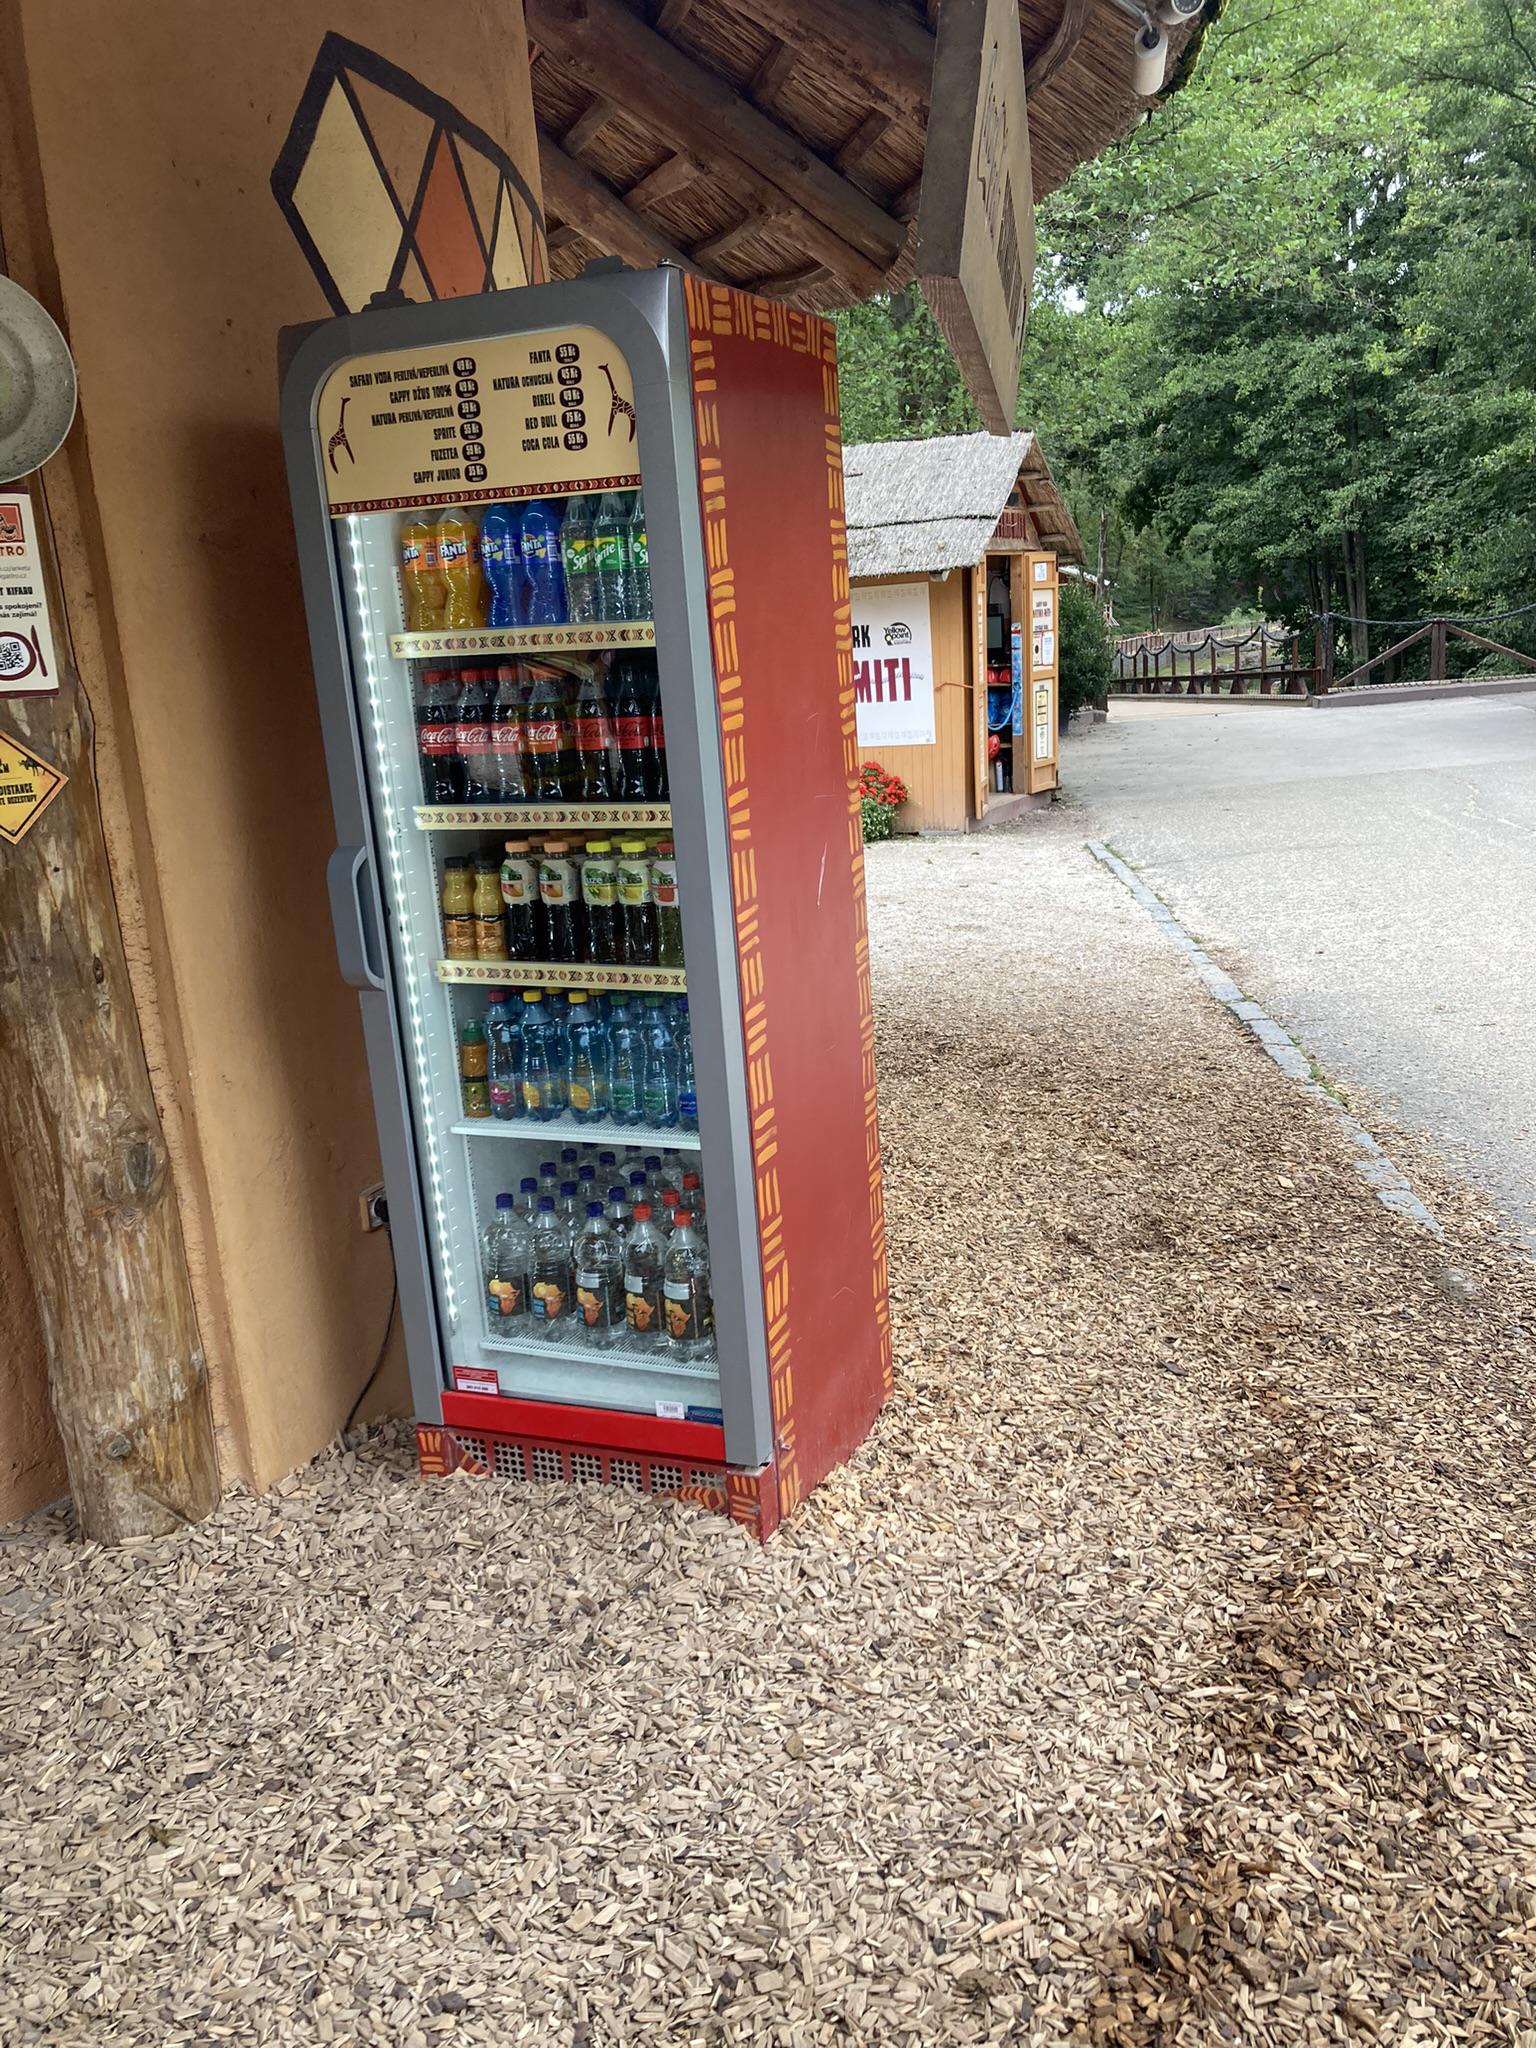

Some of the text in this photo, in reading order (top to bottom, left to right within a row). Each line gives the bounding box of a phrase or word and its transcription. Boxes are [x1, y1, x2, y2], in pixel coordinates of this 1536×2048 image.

[529, 350, 551, 364] FANTA
[350, 373, 372, 387] SAFARI
[375, 371, 392, 385] VODA
[493, 376, 520, 390] NATURA
[390, 391, 411, 403] CAPPY
[432, 385, 451, 398] 100%
[532, 393, 555, 407] BIRELL
[372, 413, 397, 426] NATURA
[525, 417, 538, 430] RED
[541, 415, 557, 428] BULL
[434, 427, 456, 440] SPRITE
[522, 438, 540, 452] COCA
[542, 436, 560, 449] COLA
[431, 448, 458, 461] FUZETEA
[414, 470, 434, 484] CAPPY
[437, 468, 461, 481] JUNIOR
[440, 544, 467, 557] FANTA
[884, 626, 906, 634] Yellow
